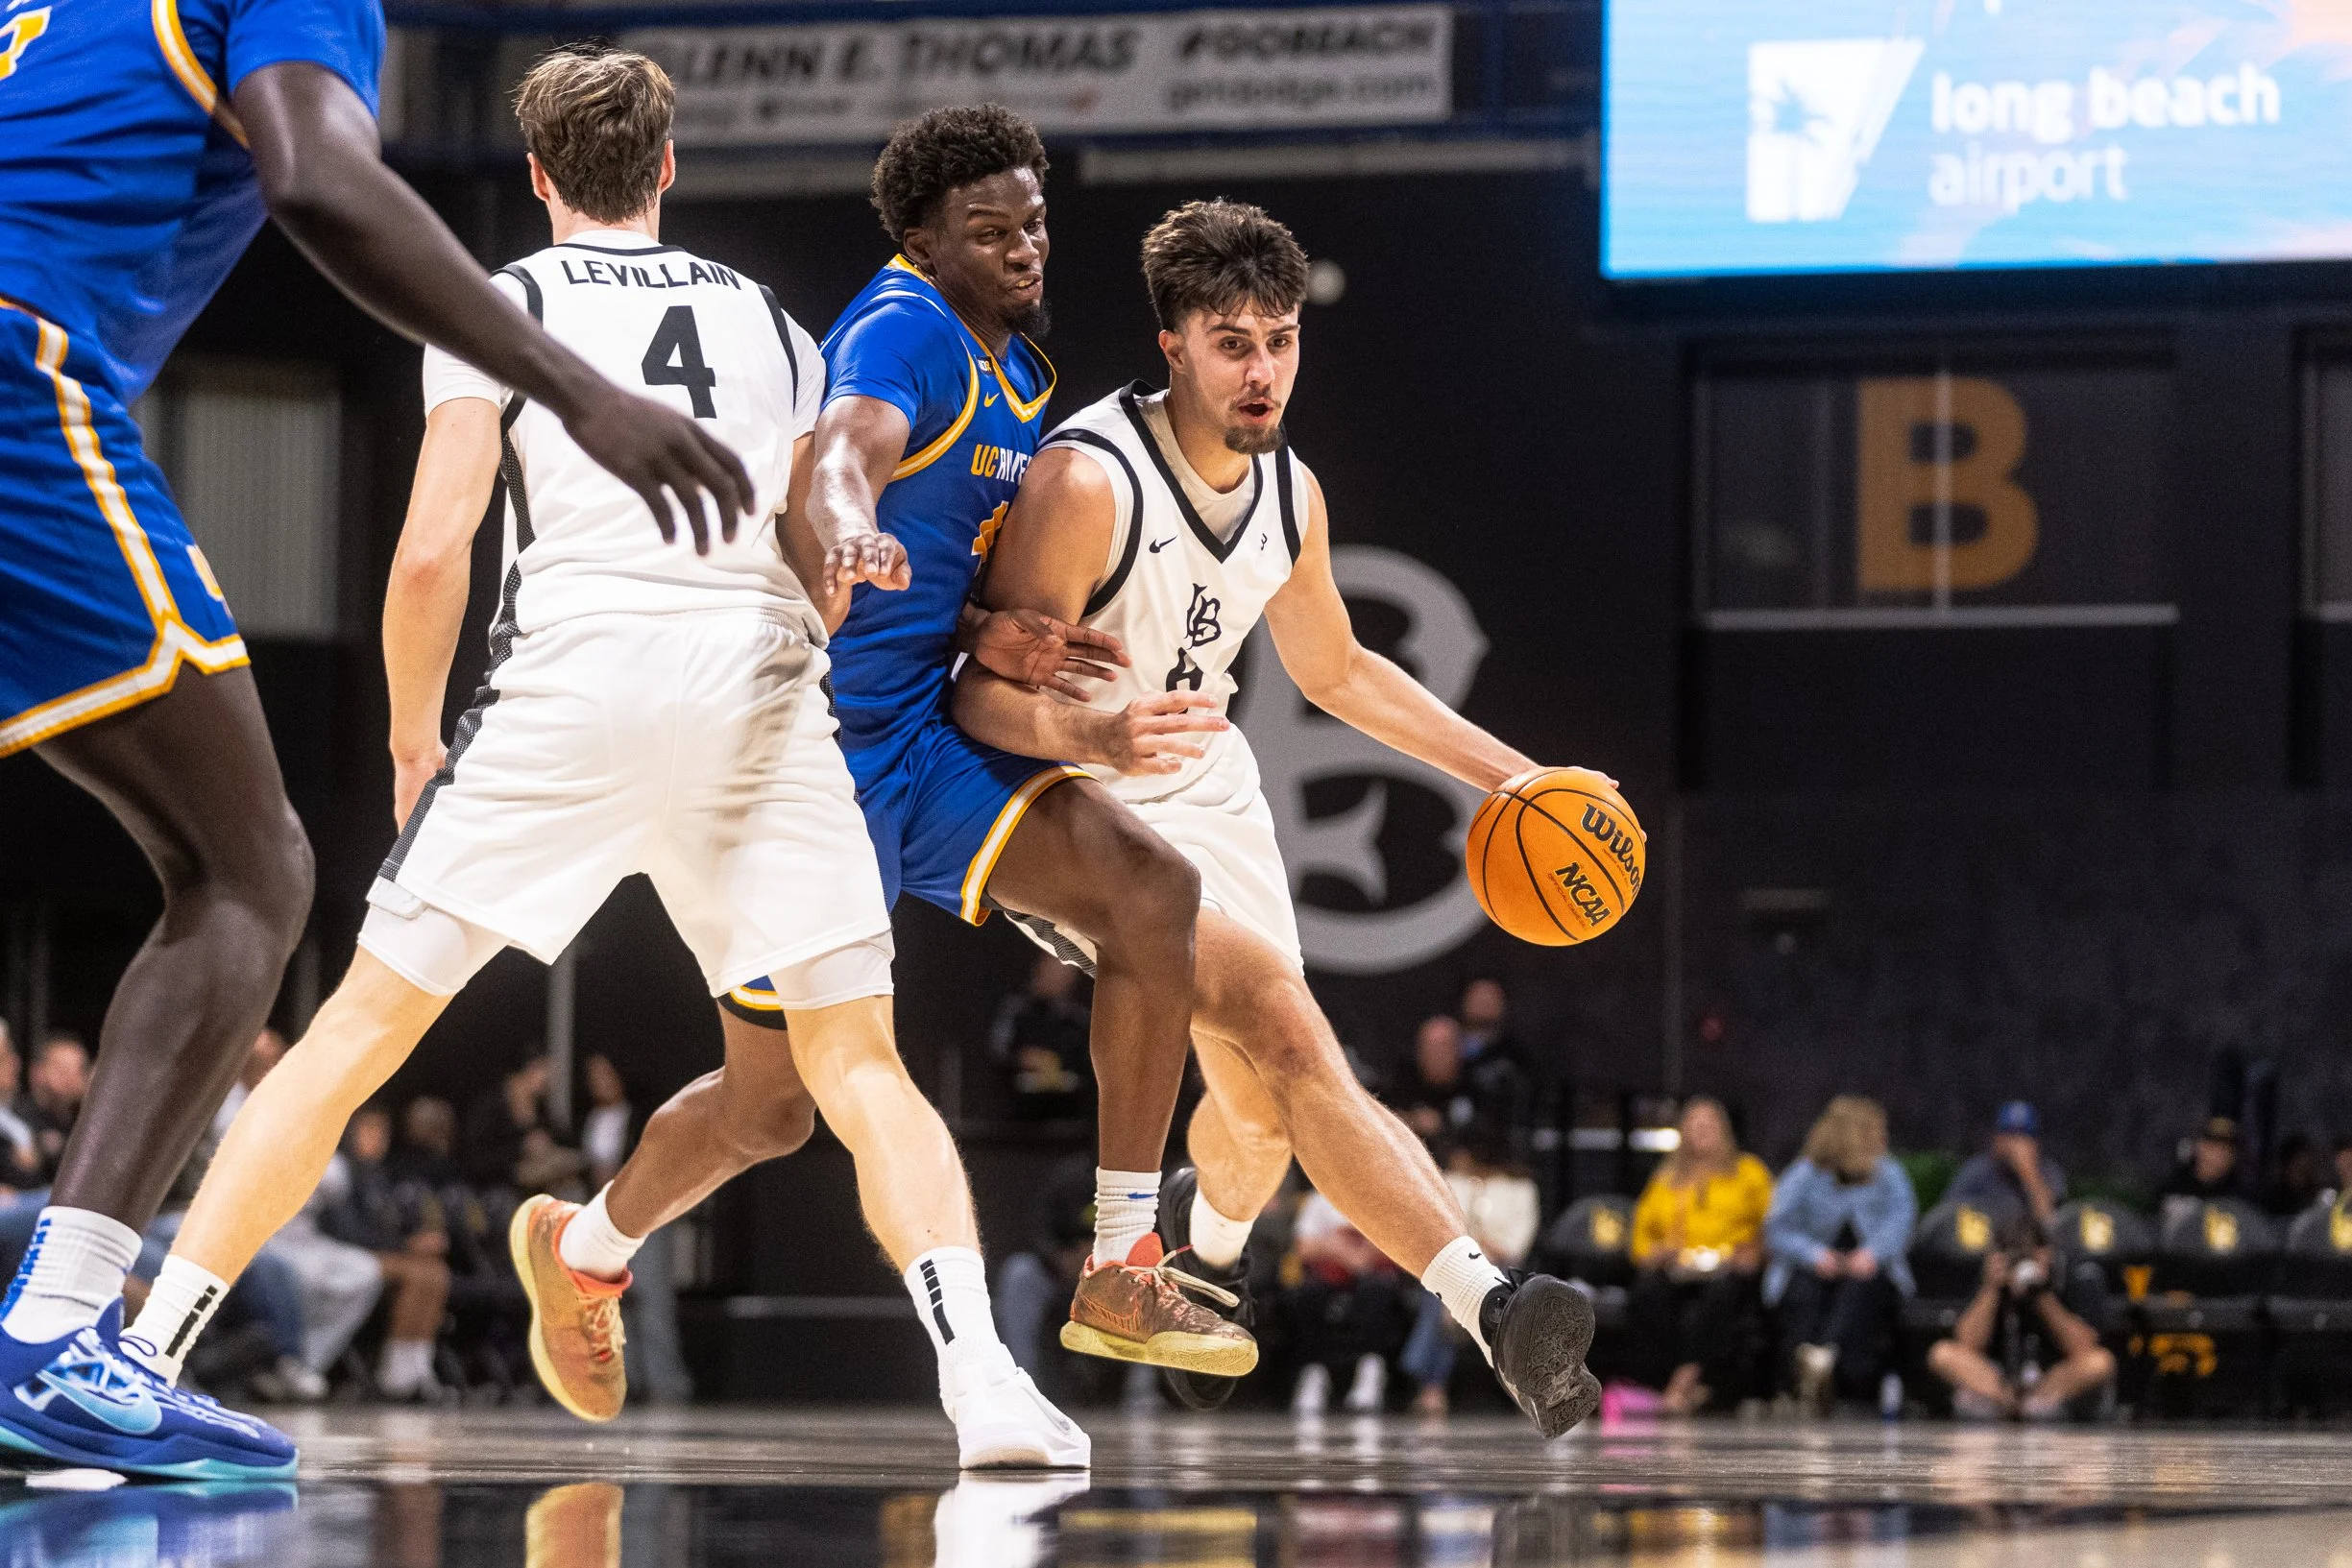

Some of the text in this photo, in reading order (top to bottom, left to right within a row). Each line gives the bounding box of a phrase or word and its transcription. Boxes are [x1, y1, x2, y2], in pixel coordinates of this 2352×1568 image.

[1931, 62, 2281, 144] long beach
[1928, 144, 2130, 207] airport
[560, 259, 742, 291] LEVILLAIN
[641, 304, 717, 420] 4
[1856, 376, 2039, 591] B
[1580, 802, 1640, 901] Wilson
[1554, 860, 1612, 929] NCAA
